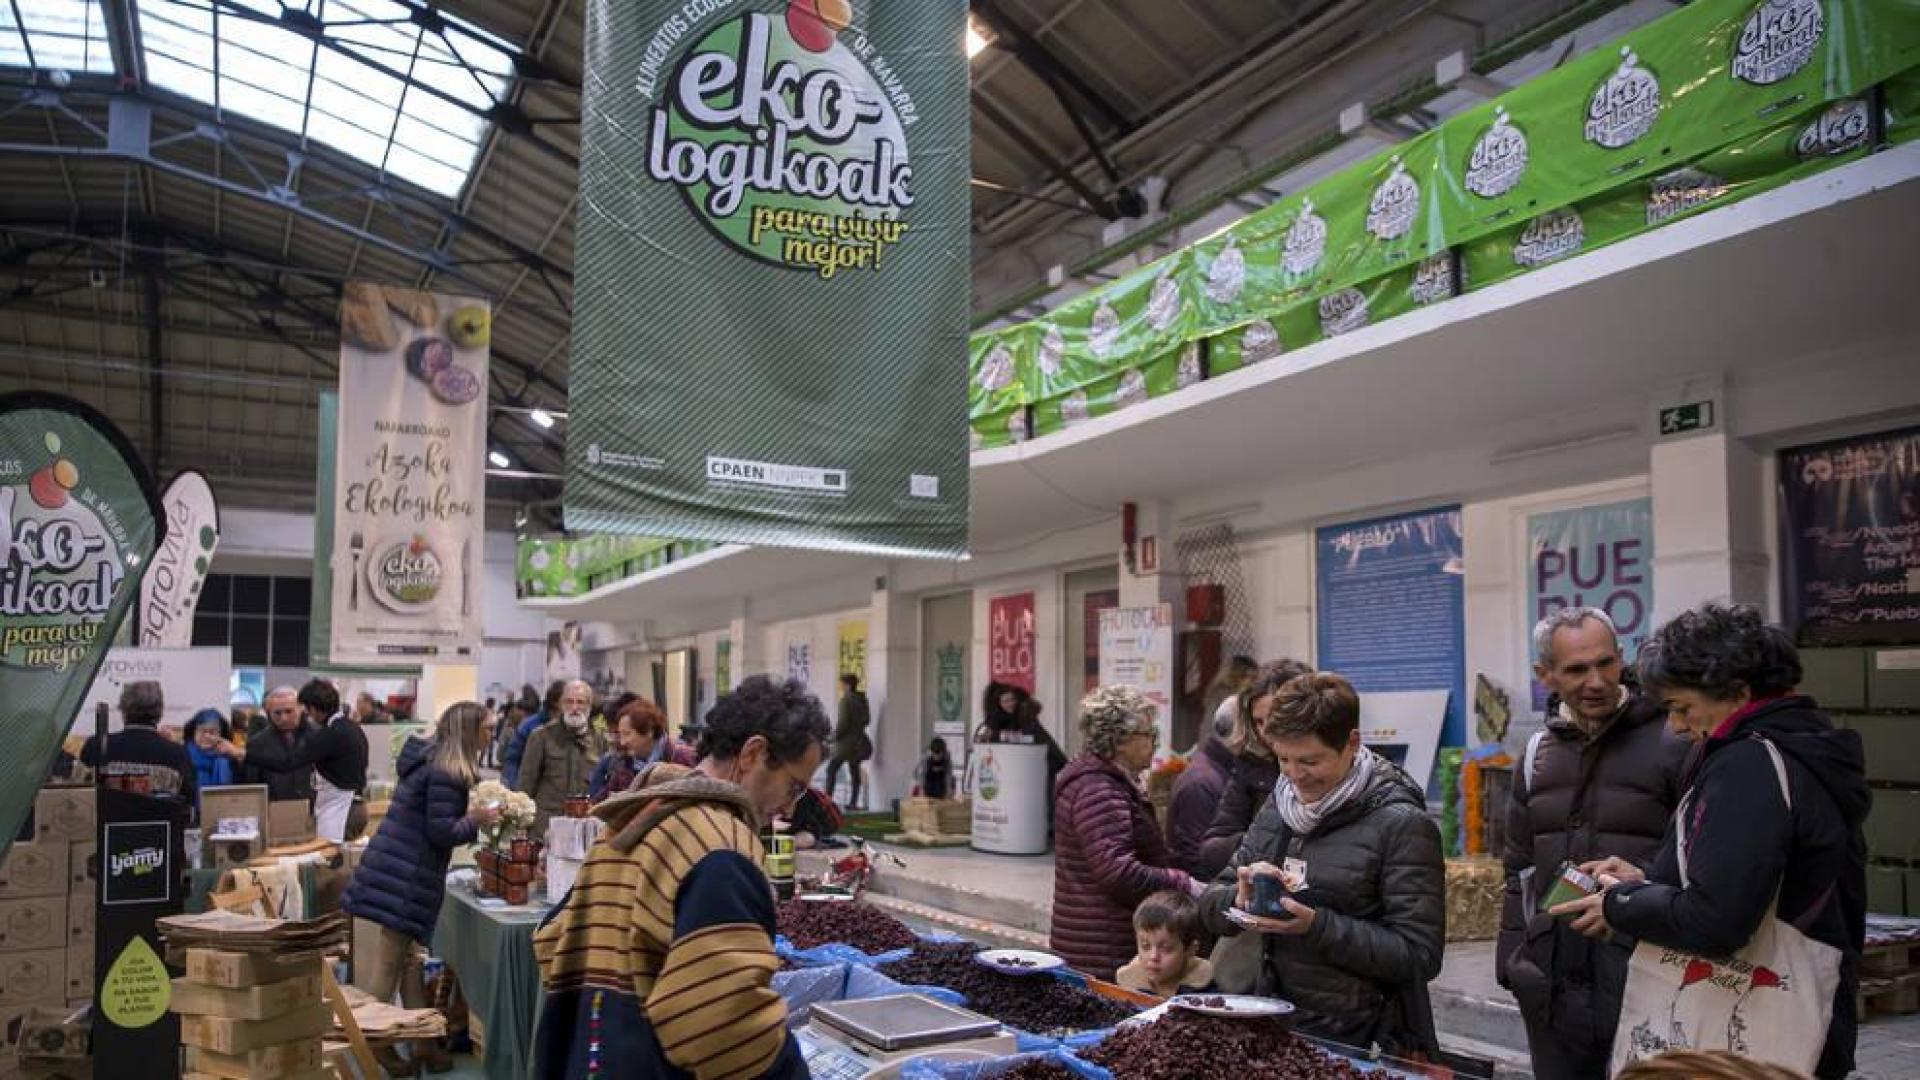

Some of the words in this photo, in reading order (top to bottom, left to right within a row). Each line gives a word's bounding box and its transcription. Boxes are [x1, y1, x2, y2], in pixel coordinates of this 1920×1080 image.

[635, 14, 688, 98] ALIMENTOS
[678, 13, 882, 139] eko-
[853, 36, 873, 58] DE
[868, 55, 919, 125] NAVARRA
[648, 108, 914, 216] logikoak
[751, 205, 833, 246] para
[836, 213, 909, 243] vivir
[784, 237, 884, 278] mejor!
[366, 442, 452, 479] Azoka
[711, 462, 765, 481] CPAEN
[345, 478, 475, 523] Ekologikoa
[993, 648, 1033, 674] BLO
